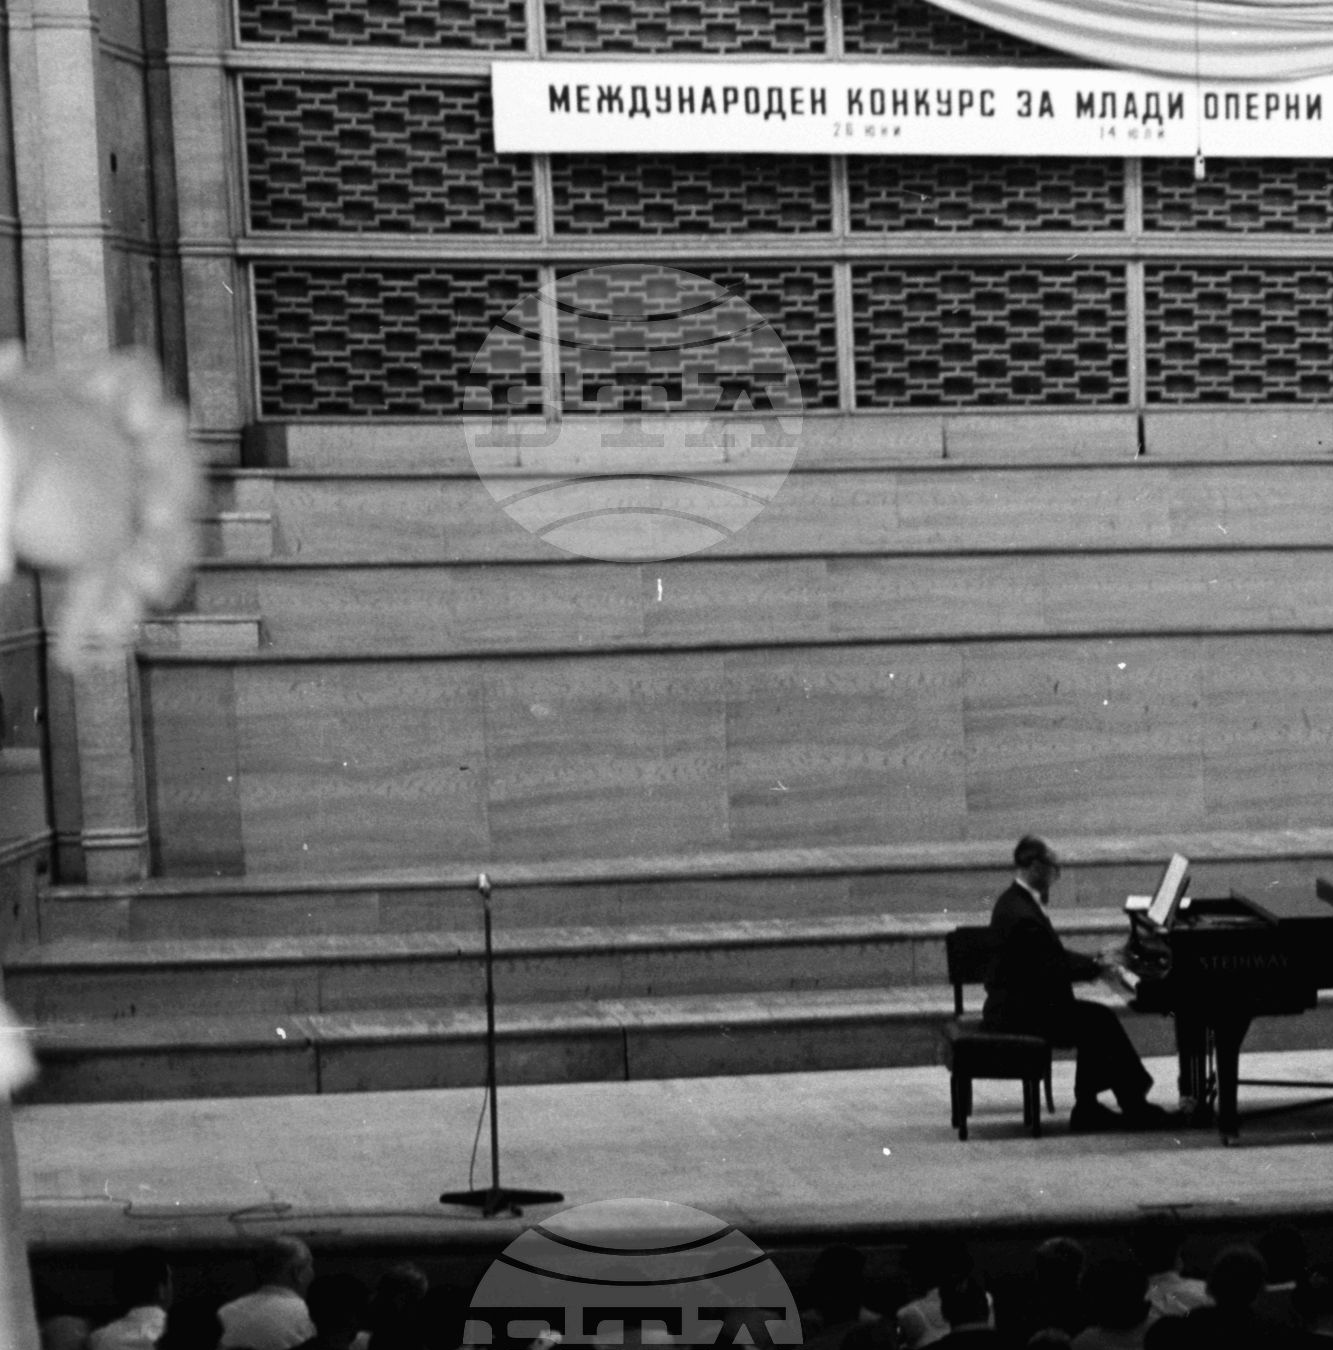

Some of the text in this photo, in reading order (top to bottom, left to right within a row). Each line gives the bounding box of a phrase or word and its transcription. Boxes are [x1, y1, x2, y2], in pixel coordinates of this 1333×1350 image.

[547, 83, 828, 120] МЕЖДУНАРОДЕН
[846, 87, 996, 117] КОНКУРС
[1016, 89, 1055, 118] ЗА
[1075, 90, 1185, 126] МЛАДИ
[1203, 91, 1323, 121] ОПЕРНИ
